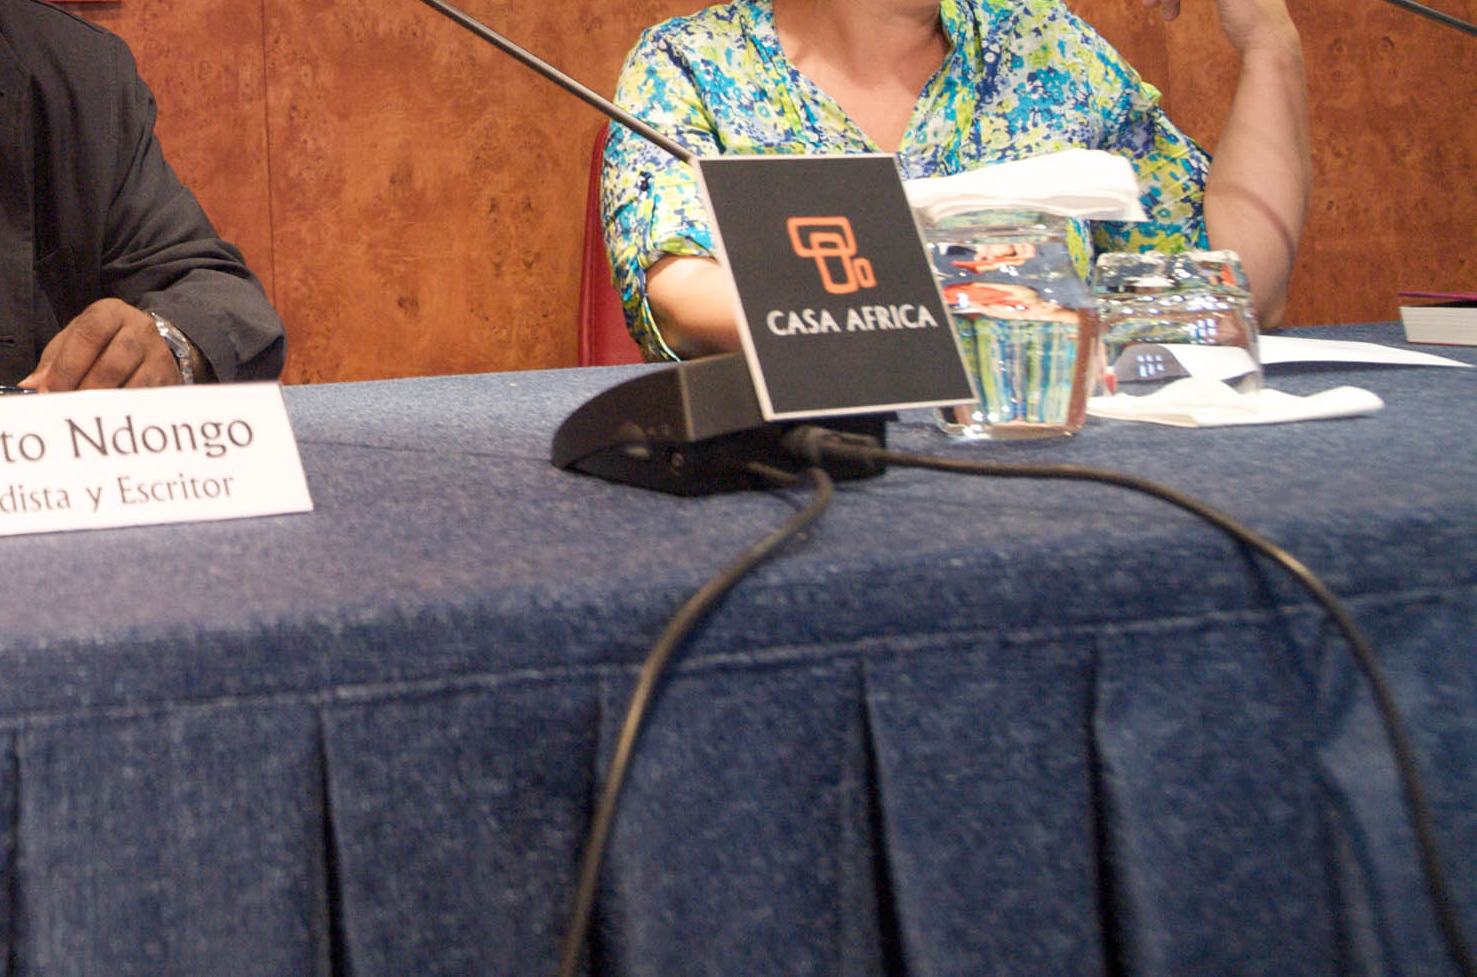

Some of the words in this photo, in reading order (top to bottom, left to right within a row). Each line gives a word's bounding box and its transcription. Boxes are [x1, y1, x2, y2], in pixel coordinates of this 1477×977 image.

[766, 308, 840, 336] CASA
[847, 304, 939, 331] AFRICA
[65, 414, 255, 458] Ndongo
[87, 484, 104, 512] y
[116, 471, 235, 505] Escritor
